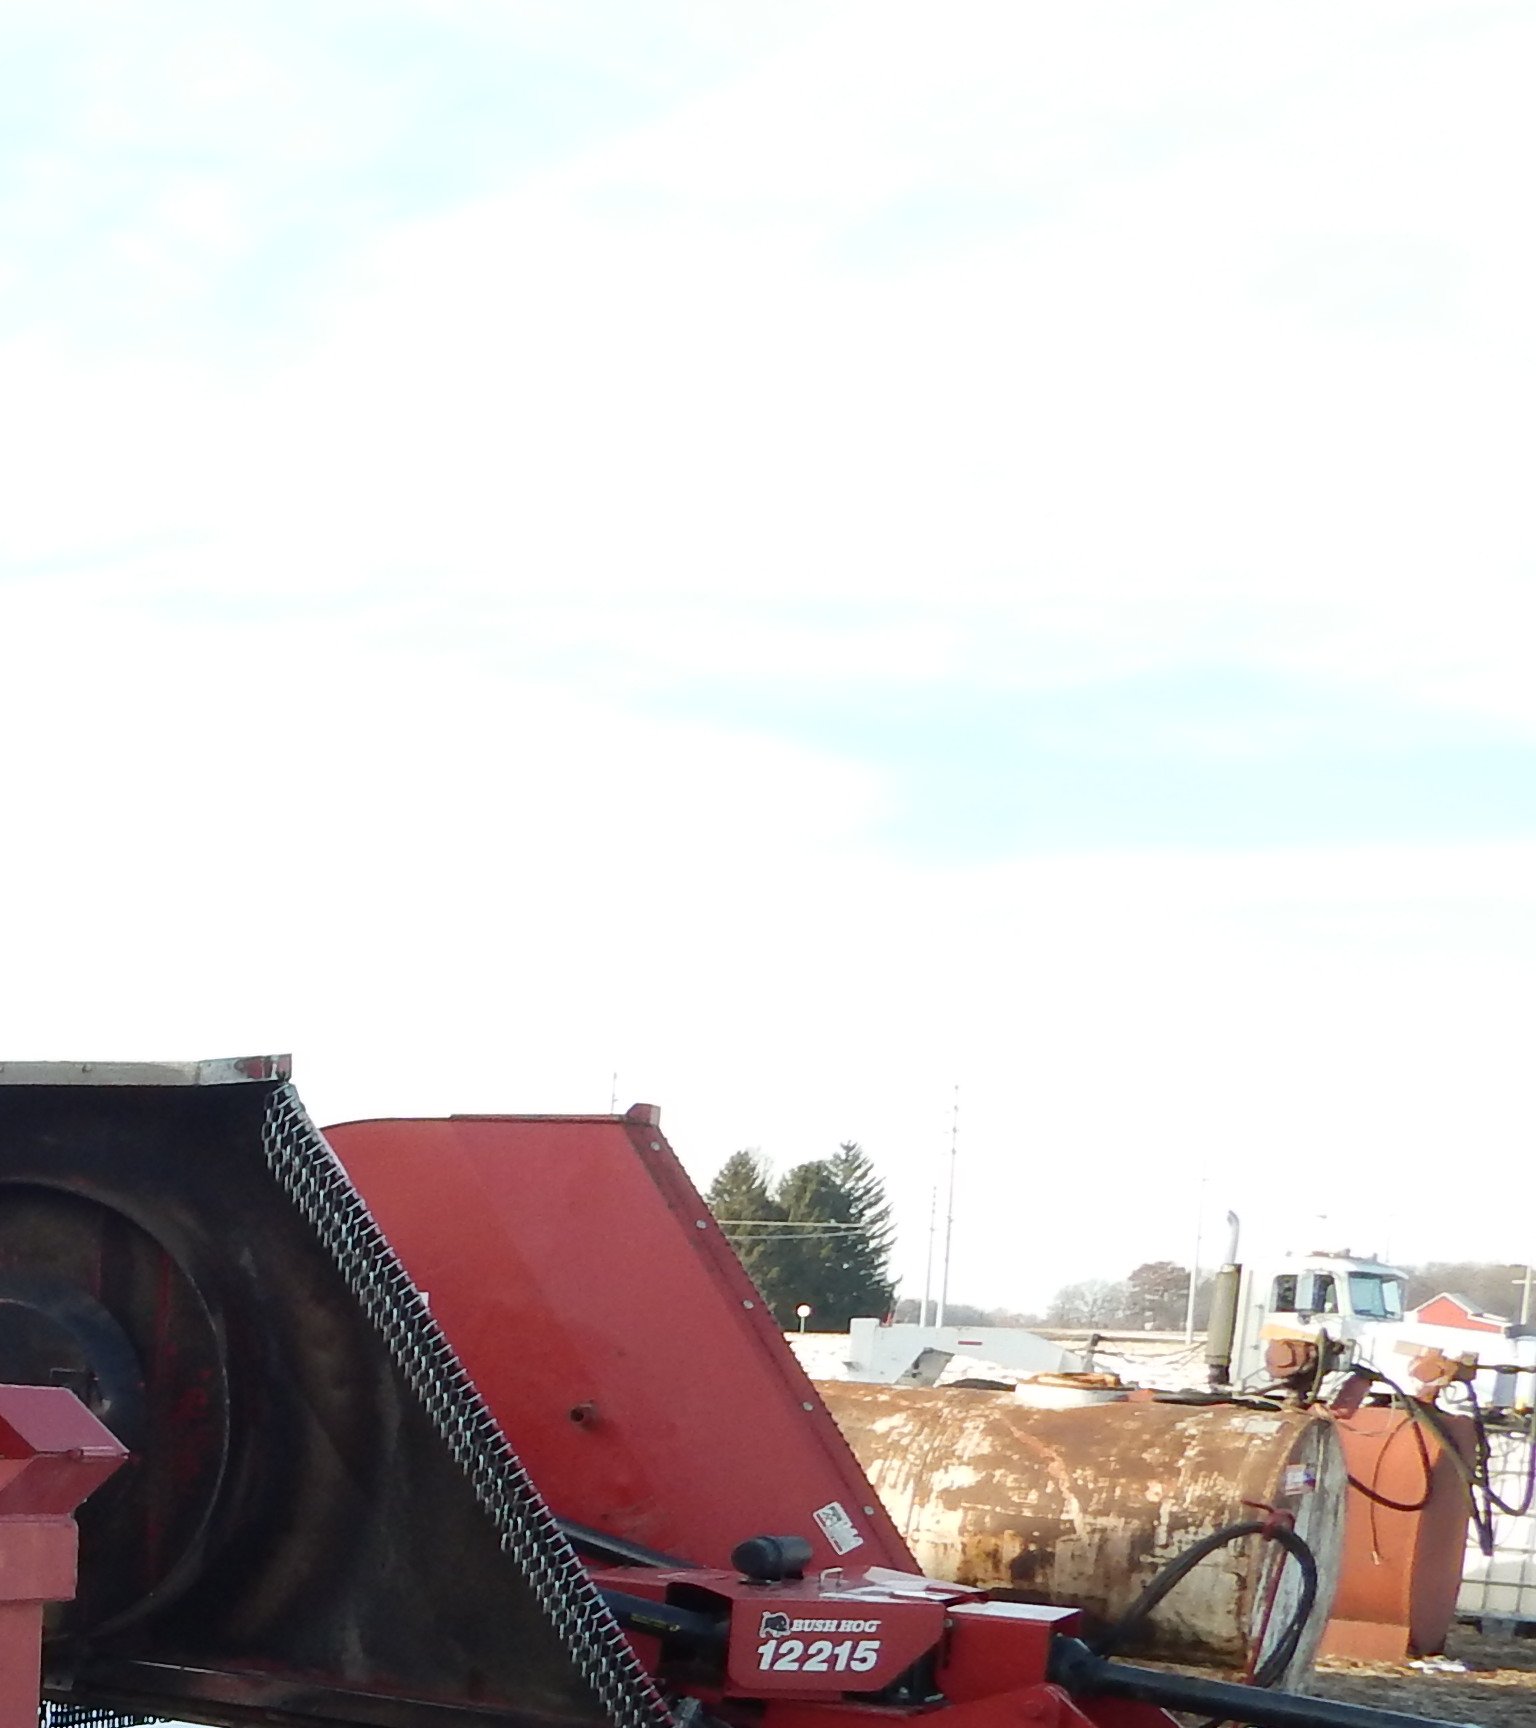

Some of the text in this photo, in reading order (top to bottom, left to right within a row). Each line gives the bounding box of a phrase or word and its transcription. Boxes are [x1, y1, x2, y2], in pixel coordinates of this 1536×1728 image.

[790, 1619, 882, 1633] BUSH HOG
[757, 1639, 881, 1672] 12215
